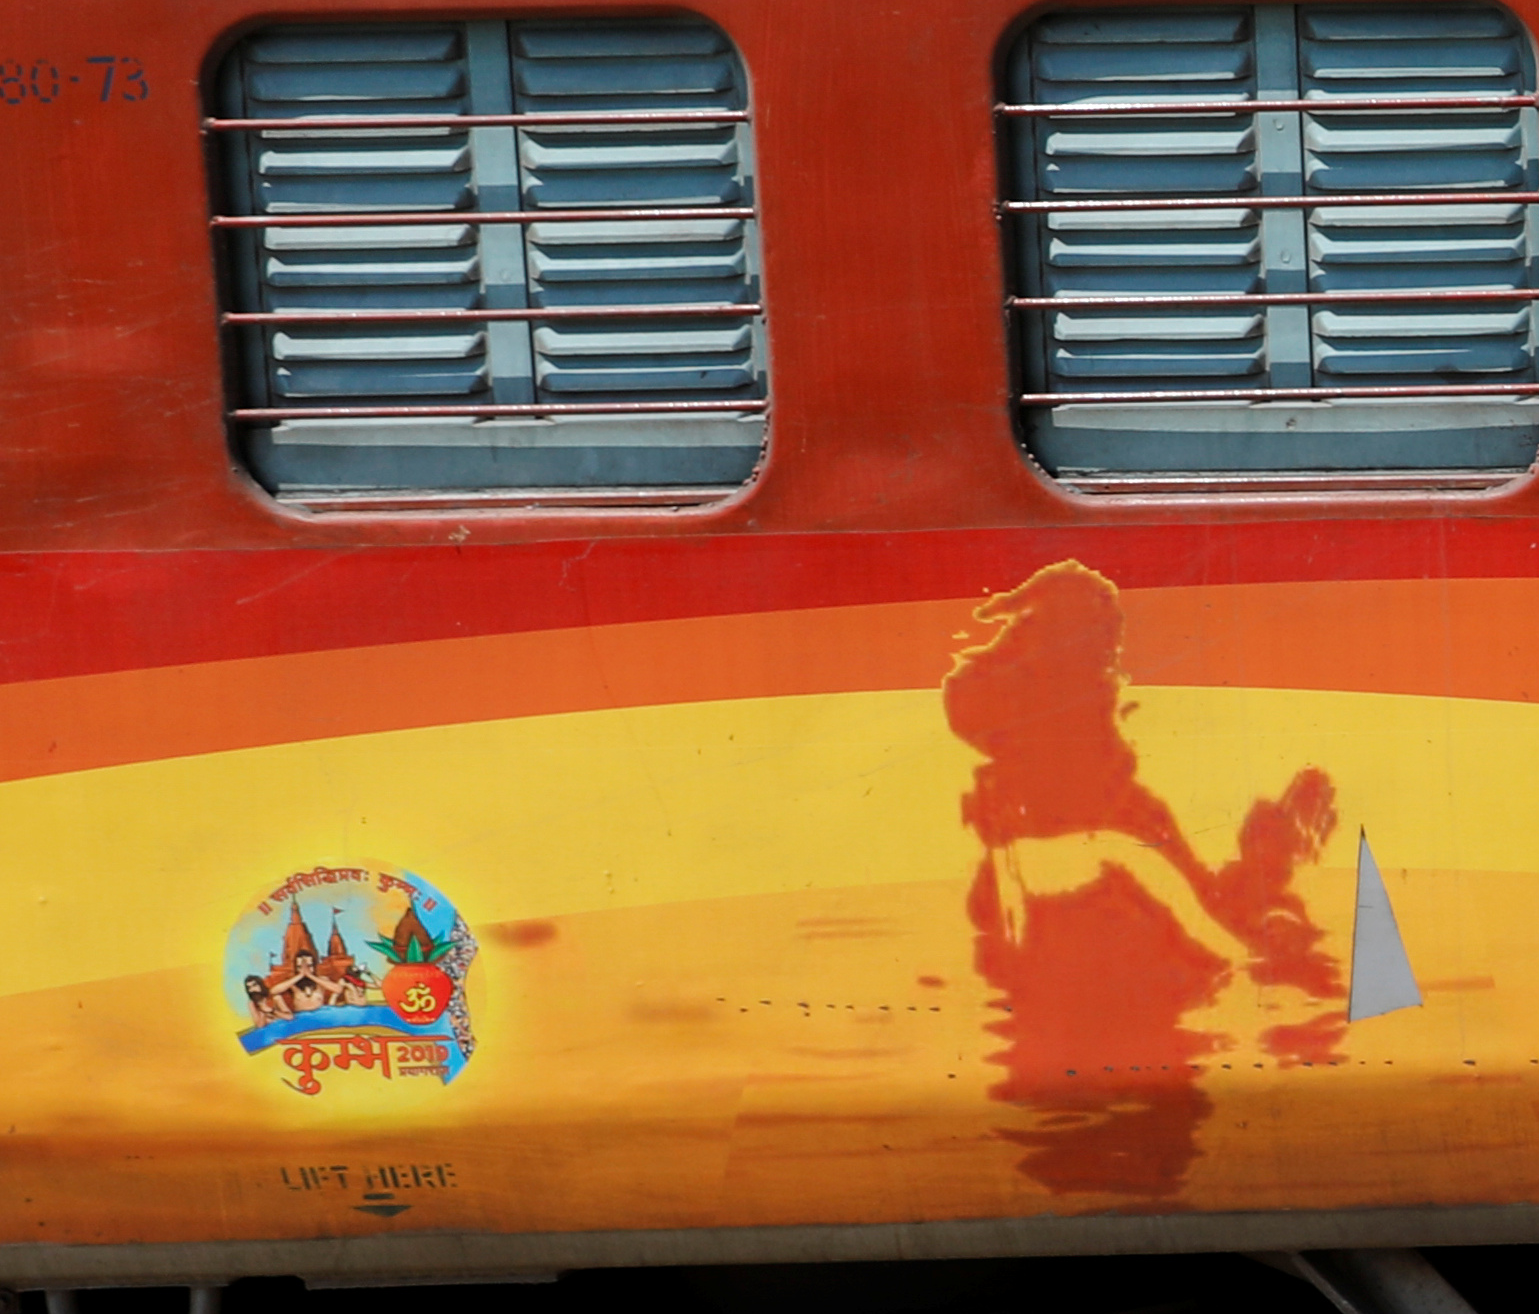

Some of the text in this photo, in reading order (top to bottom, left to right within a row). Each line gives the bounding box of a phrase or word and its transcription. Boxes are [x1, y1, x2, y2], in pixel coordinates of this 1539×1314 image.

[0, 55, 149, 105] 80-73
[396, 1044, 449, 1063] 2019
[280, 1162, 458, 1190] LIFT HERE
